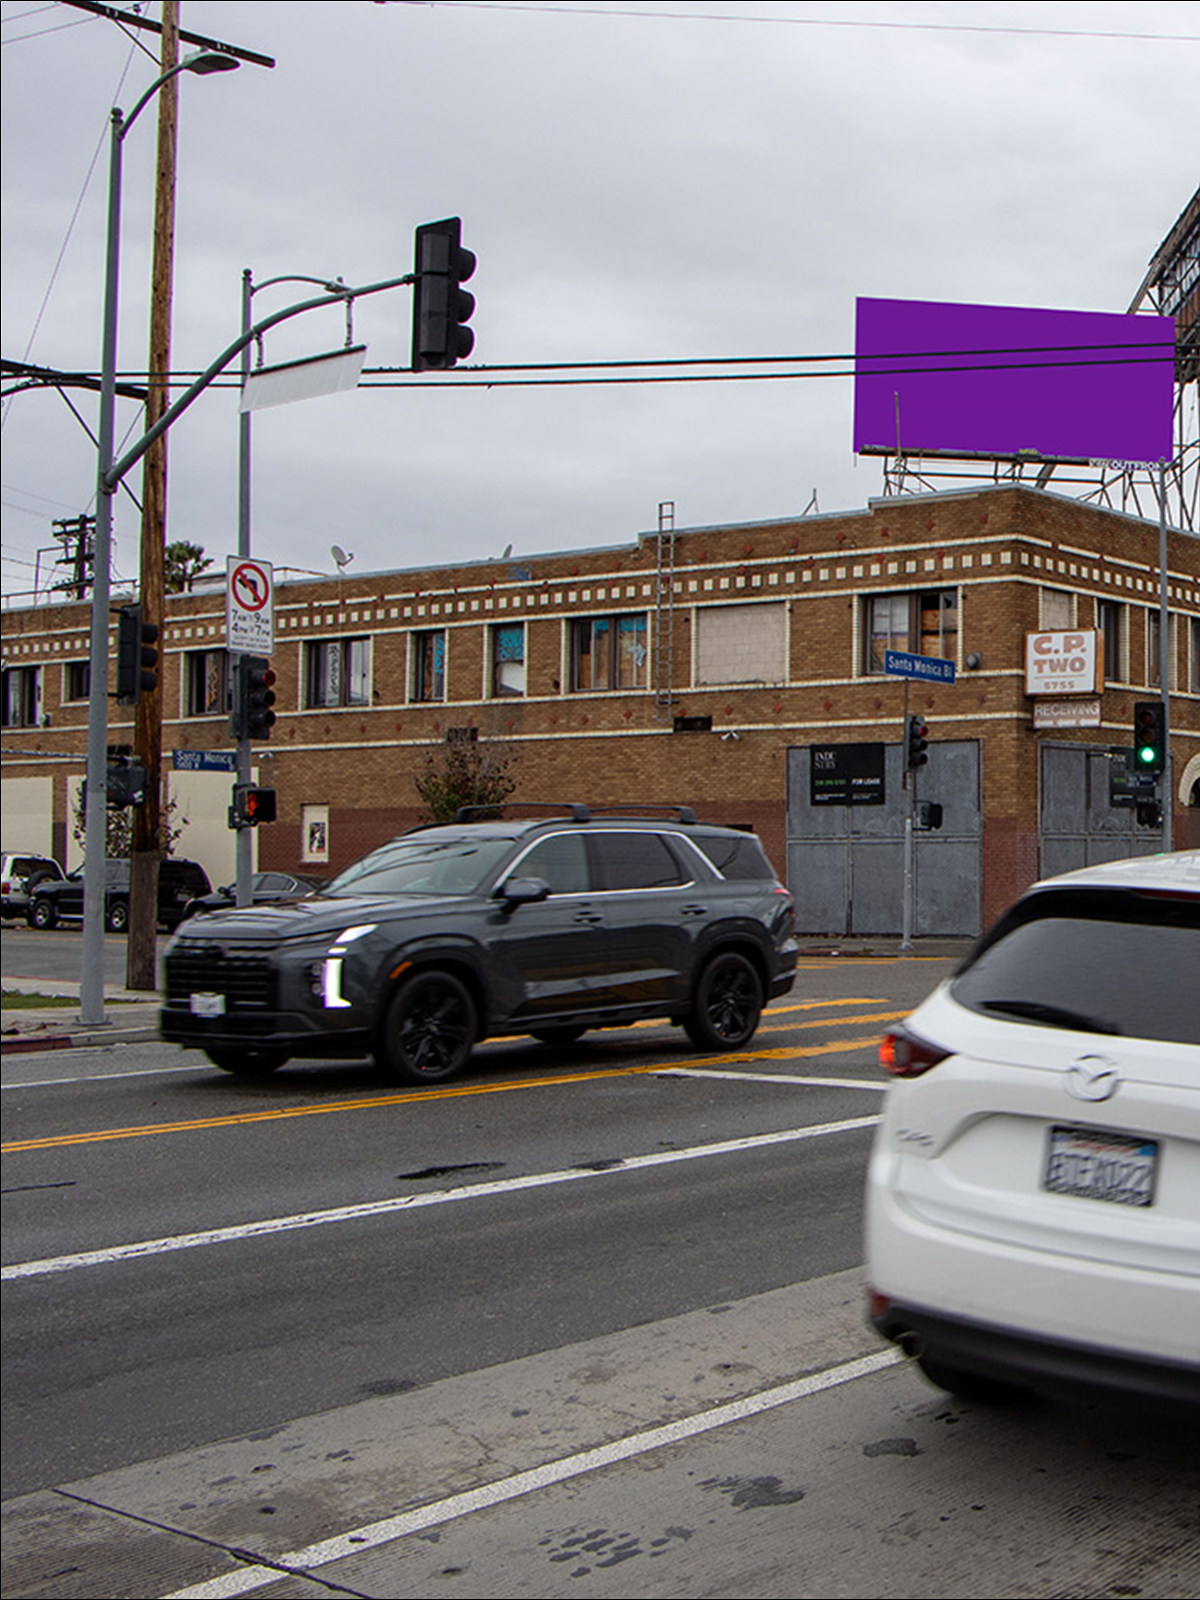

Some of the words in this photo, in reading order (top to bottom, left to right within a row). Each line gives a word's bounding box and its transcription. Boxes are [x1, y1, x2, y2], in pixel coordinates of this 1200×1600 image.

[1033, 635, 1087, 655] C.P.
[888, 655, 912, 672] Santa
[914, 659, 942, 677] Monica
[1033, 657, 1086, 674] TWO
[1034, 701, 1099, 717] RECEIVING
